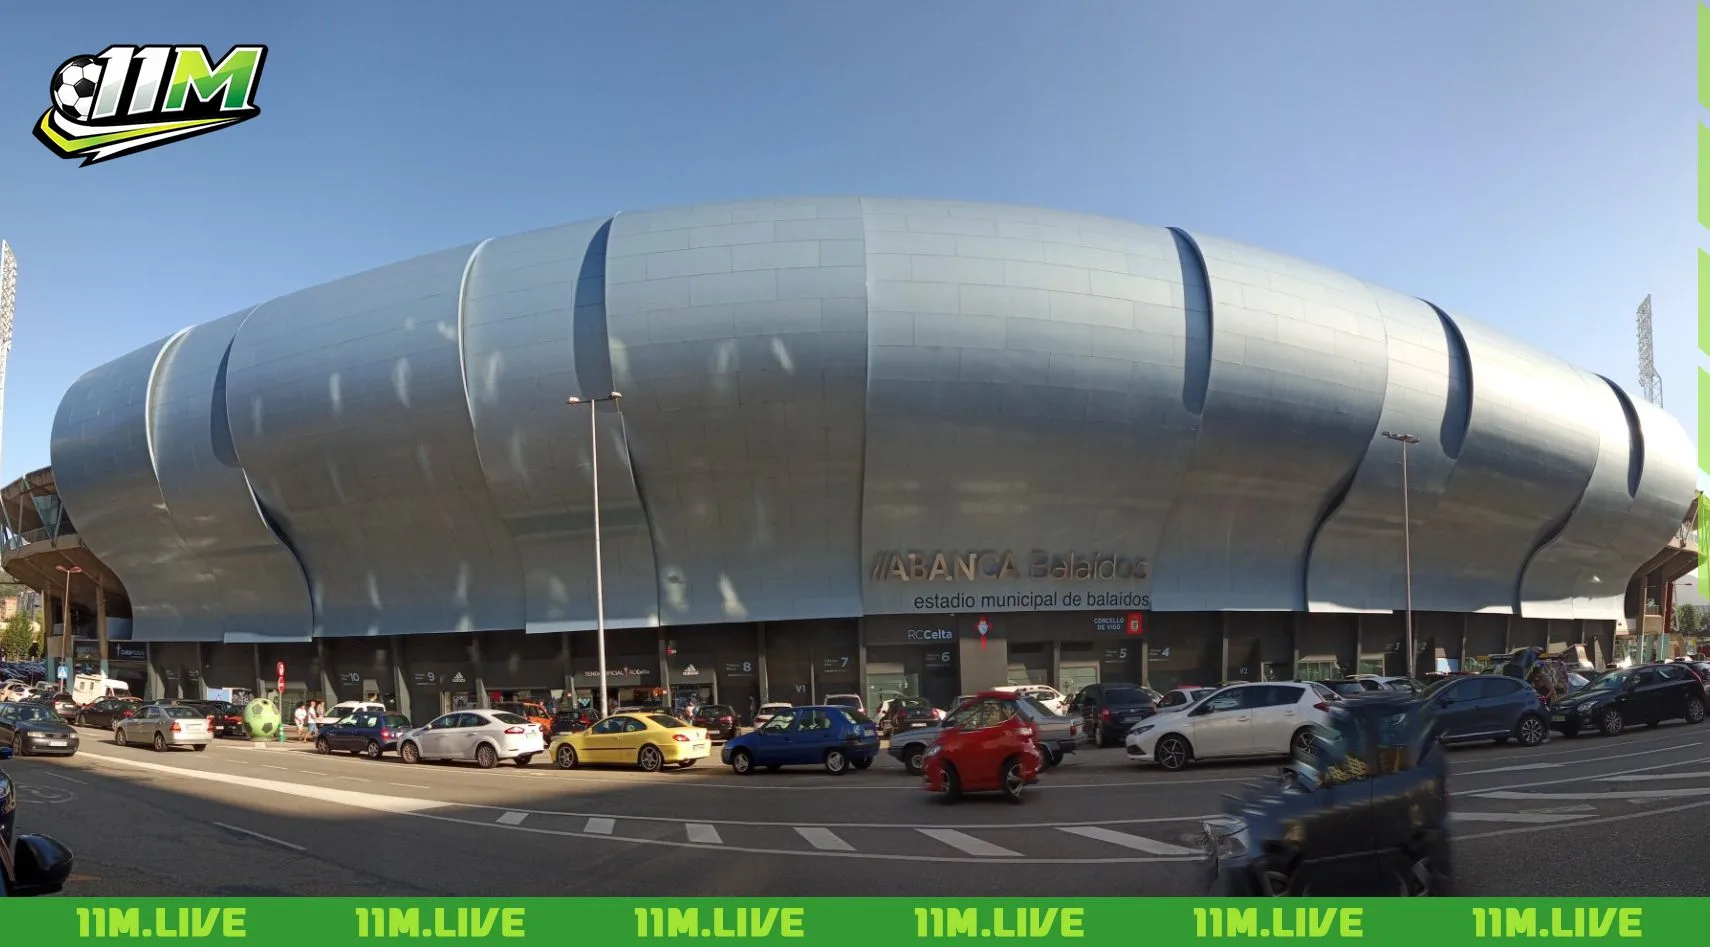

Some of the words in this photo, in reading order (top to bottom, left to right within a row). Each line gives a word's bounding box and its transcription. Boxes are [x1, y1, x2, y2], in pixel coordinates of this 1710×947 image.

[914, 592, 976, 609] estadio
[981, 591, 1057, 610] municipal
[1062, 592, 1082, 607] de
[907, 629, 953, 641] RCCelta
[941, 652, 951, 662] 6
[1119, 648, 1128, 658] 5
[1162, 647, 1170, 657] 4
[742, 661, 752, 672] 8
[840, 657, 849, 668] 7
[350, 672, 360, 682] 10
[427, 671, 436, 682] 9
